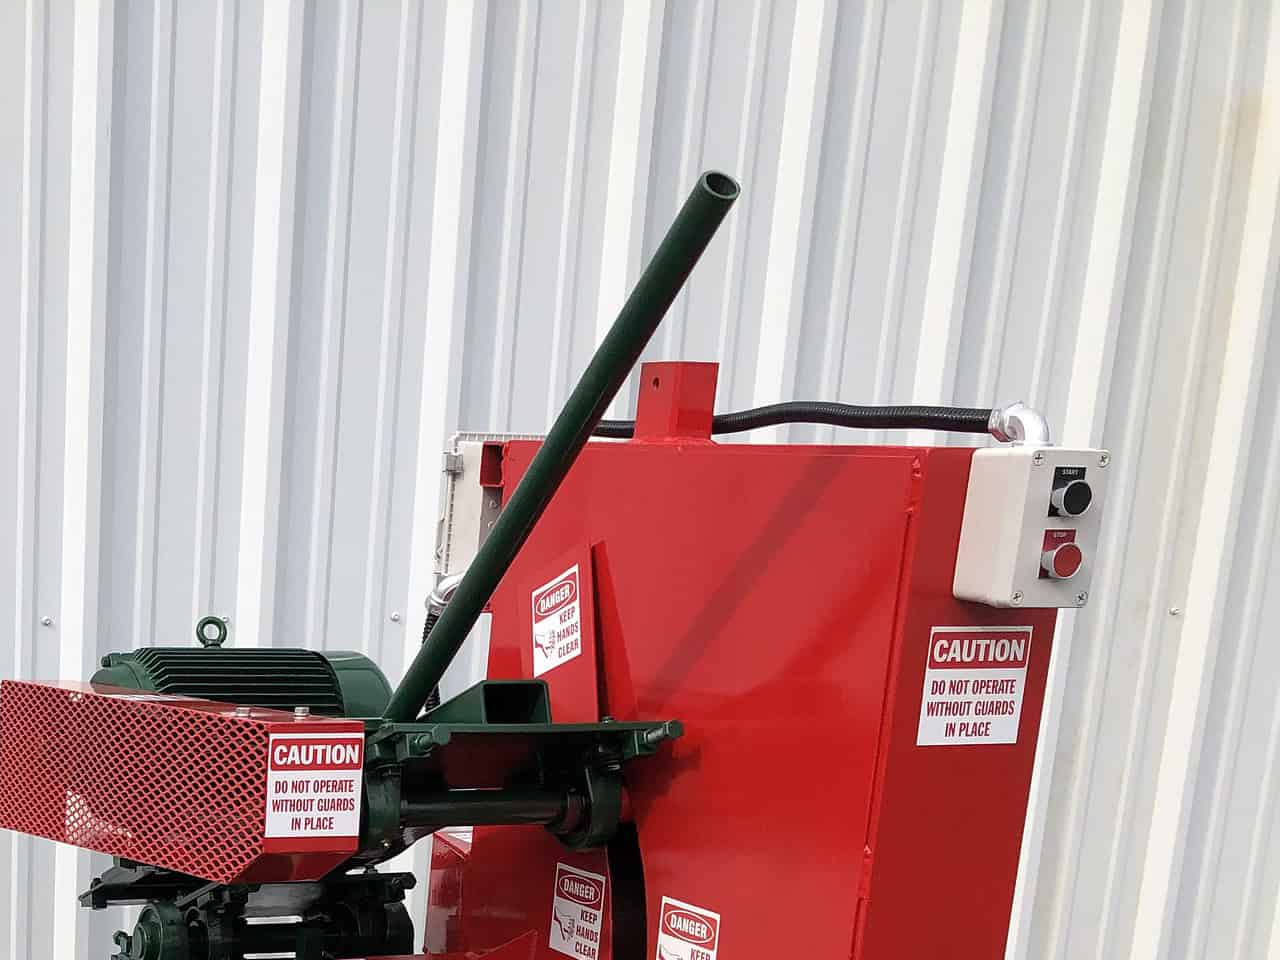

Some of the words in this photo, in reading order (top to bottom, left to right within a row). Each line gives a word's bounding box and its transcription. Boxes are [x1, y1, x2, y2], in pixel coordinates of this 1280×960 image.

[540, 583, 570, 613] DANGER
[559, 606, 576, 624] KEEP
[556, 622, 579, 642] HANDS
[558, 638, 579, 659] CLEAR
[933, 638, 1025, 663] CAUTION
[930, 679, 947, 696] DO
[948, 679, 969, 695] NOT
[971, 679, 1017, 695] OPERATE
[926, 700, 972, 717] WITHOUT
[974, 699, 1015, 716] GUARDS
[944, 722, 956, 738] IN
[958, 721, 992, 738] PLACE
[273, 744, 359, 766] CAUTION
[274, 780, 288, 794] DO
[291, 779, 311, 793] NOT
[313, 779, 354, 794] OPERATE
[271, 798, 314, 813] WITHOUT
[317, 797, 355, 812] GUARDS
[291, 816, 302, 830] IN
[304, 816, 335, 830] PLACE
[563, 878, 595, 900] DANGER
[580, 909, 597, 923] KEEP
[576, 924, 599, 943] HANDS
[670, 914, 707, 939] DANGER
[574, 941, 596, 960] CLEAR
